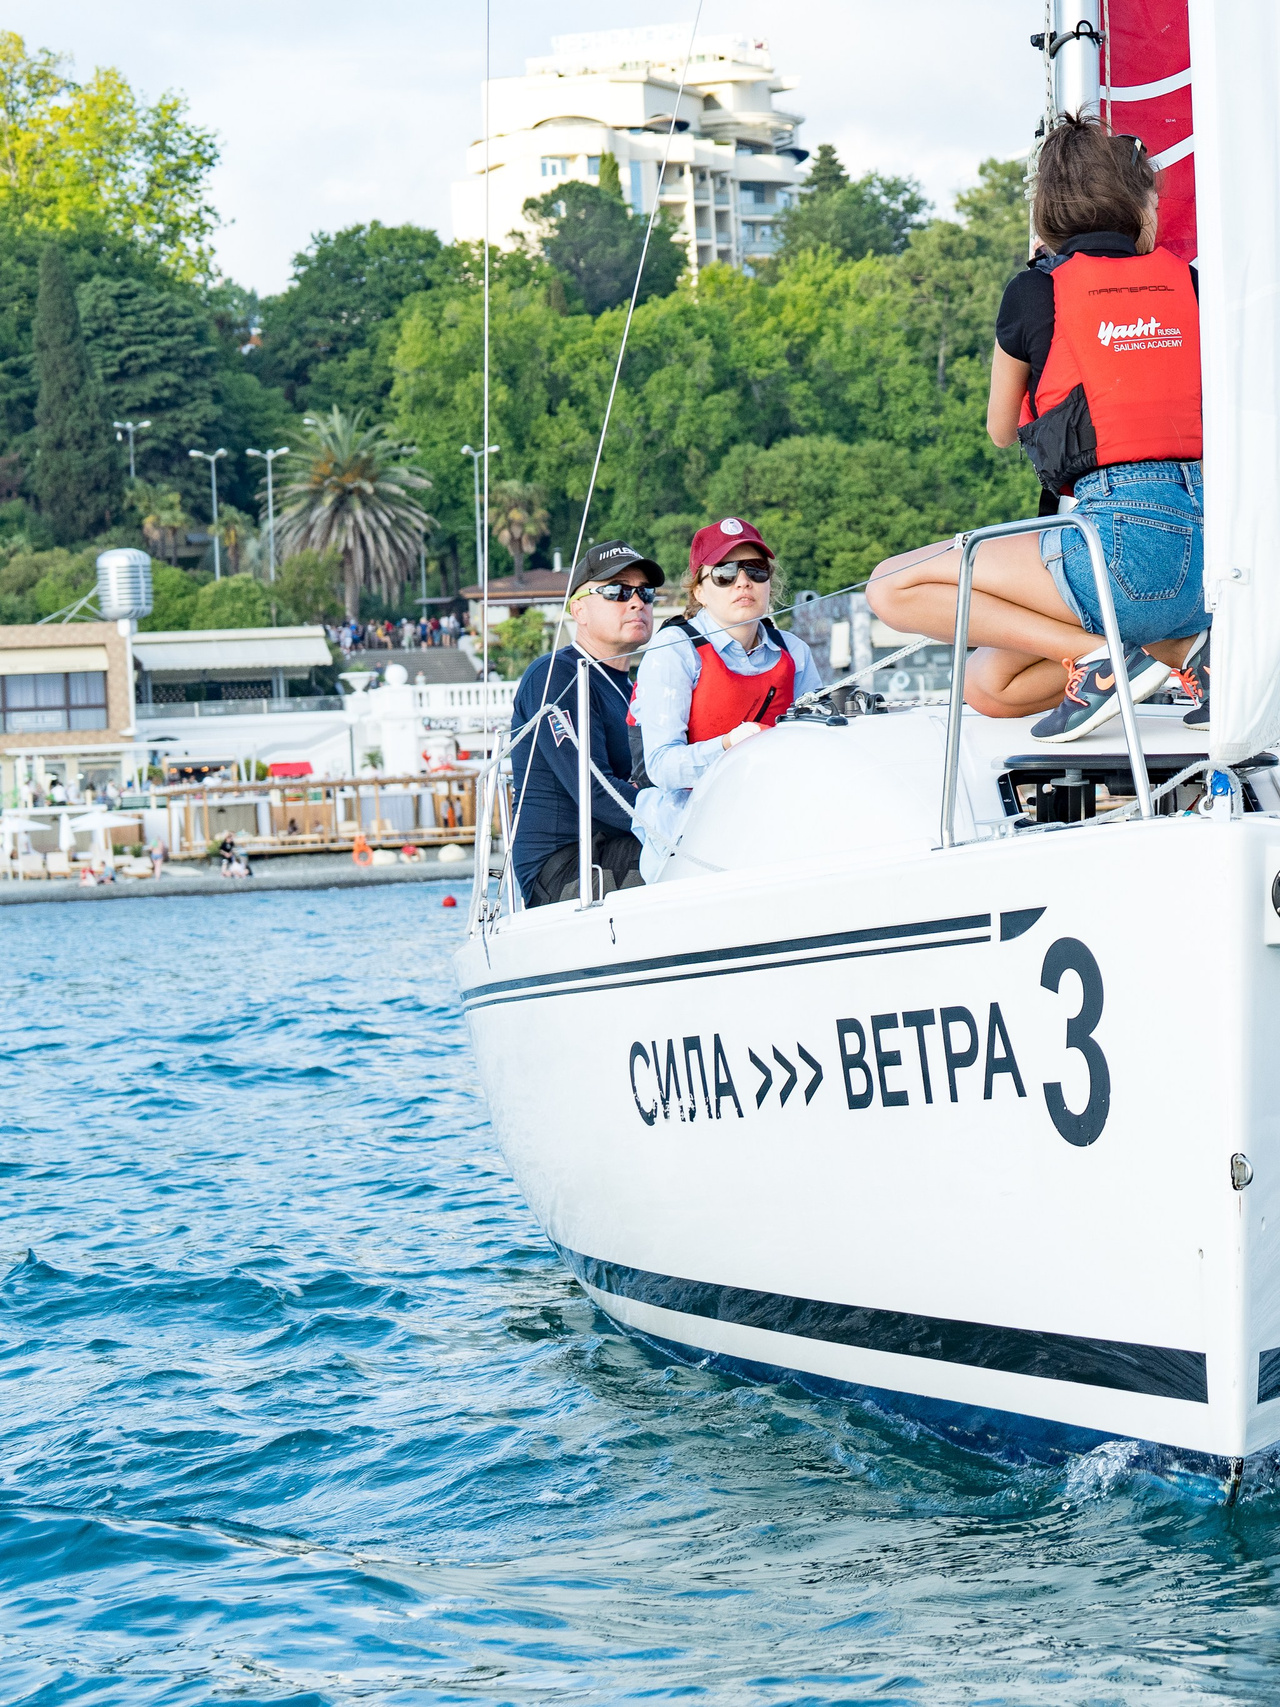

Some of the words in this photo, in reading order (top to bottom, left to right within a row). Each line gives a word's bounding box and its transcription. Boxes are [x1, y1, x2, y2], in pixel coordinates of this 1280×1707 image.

[1114, 342, 1146, 352] SAILING
[1147, 339, 1183, 350] ACADEMY
[1157, 328, 1182, 336] RUSSIA
[629, 1033, 744, 1126] СИЛА
[836, 1002, 1027, 1110] ВЕТРА
[1040, 936, 1111, 1147] 3
